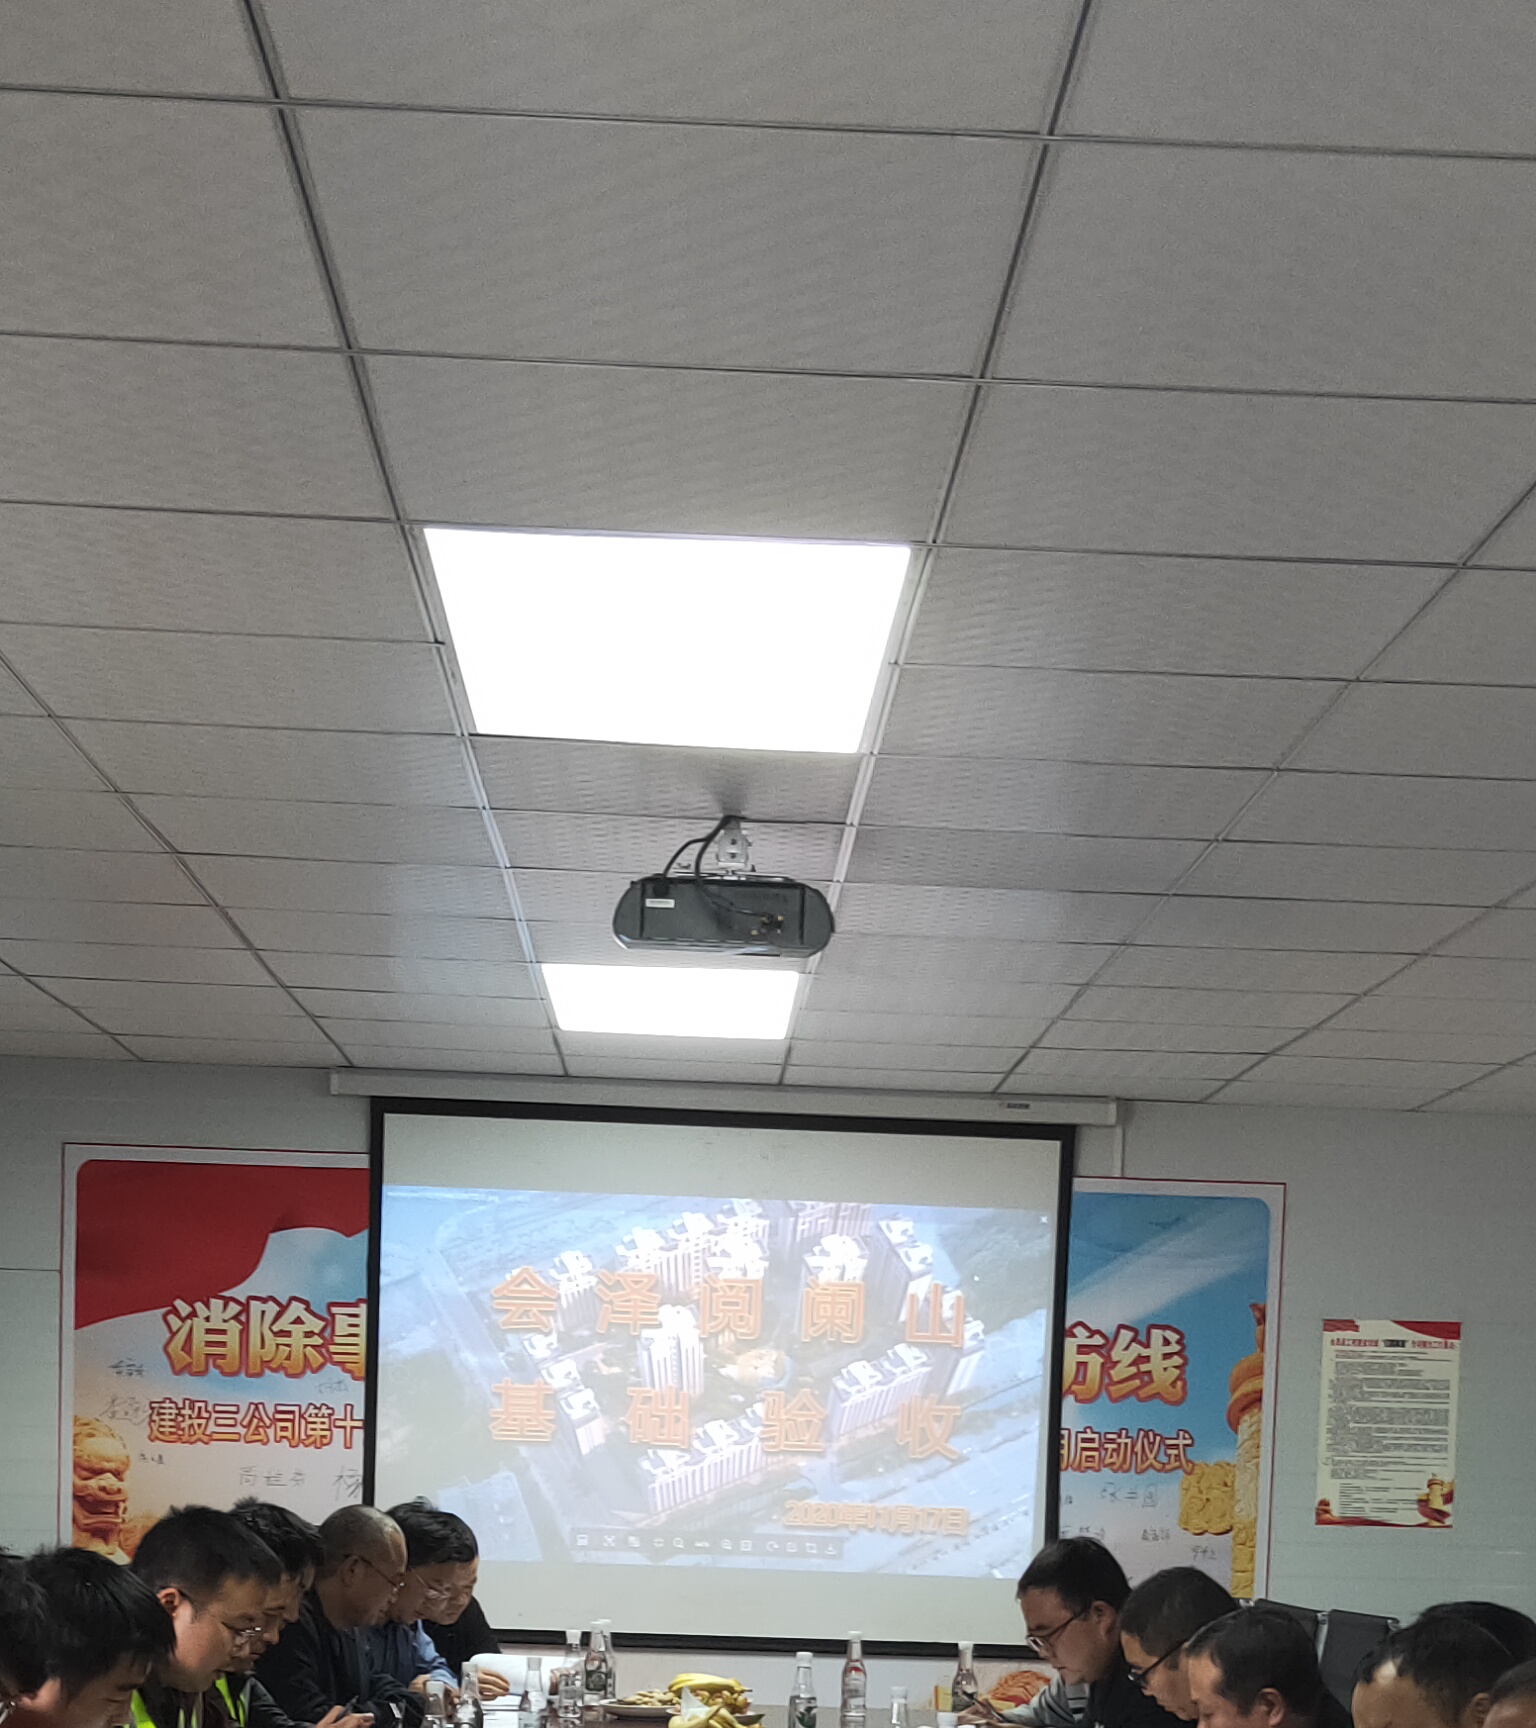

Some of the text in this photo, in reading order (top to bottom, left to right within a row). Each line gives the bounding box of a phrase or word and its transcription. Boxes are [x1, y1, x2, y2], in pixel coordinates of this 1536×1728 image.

[491, 1264, 966, 1349] 会泽阅阑山
[148, 1397, 364, 1449] 建投三公司第十
[489, 1376, 963, 1461] 基础验收
[1060, 1426, 1195, 1476] 启动仪式
[784, 1499, 969, 1537] 2020年11月17日
